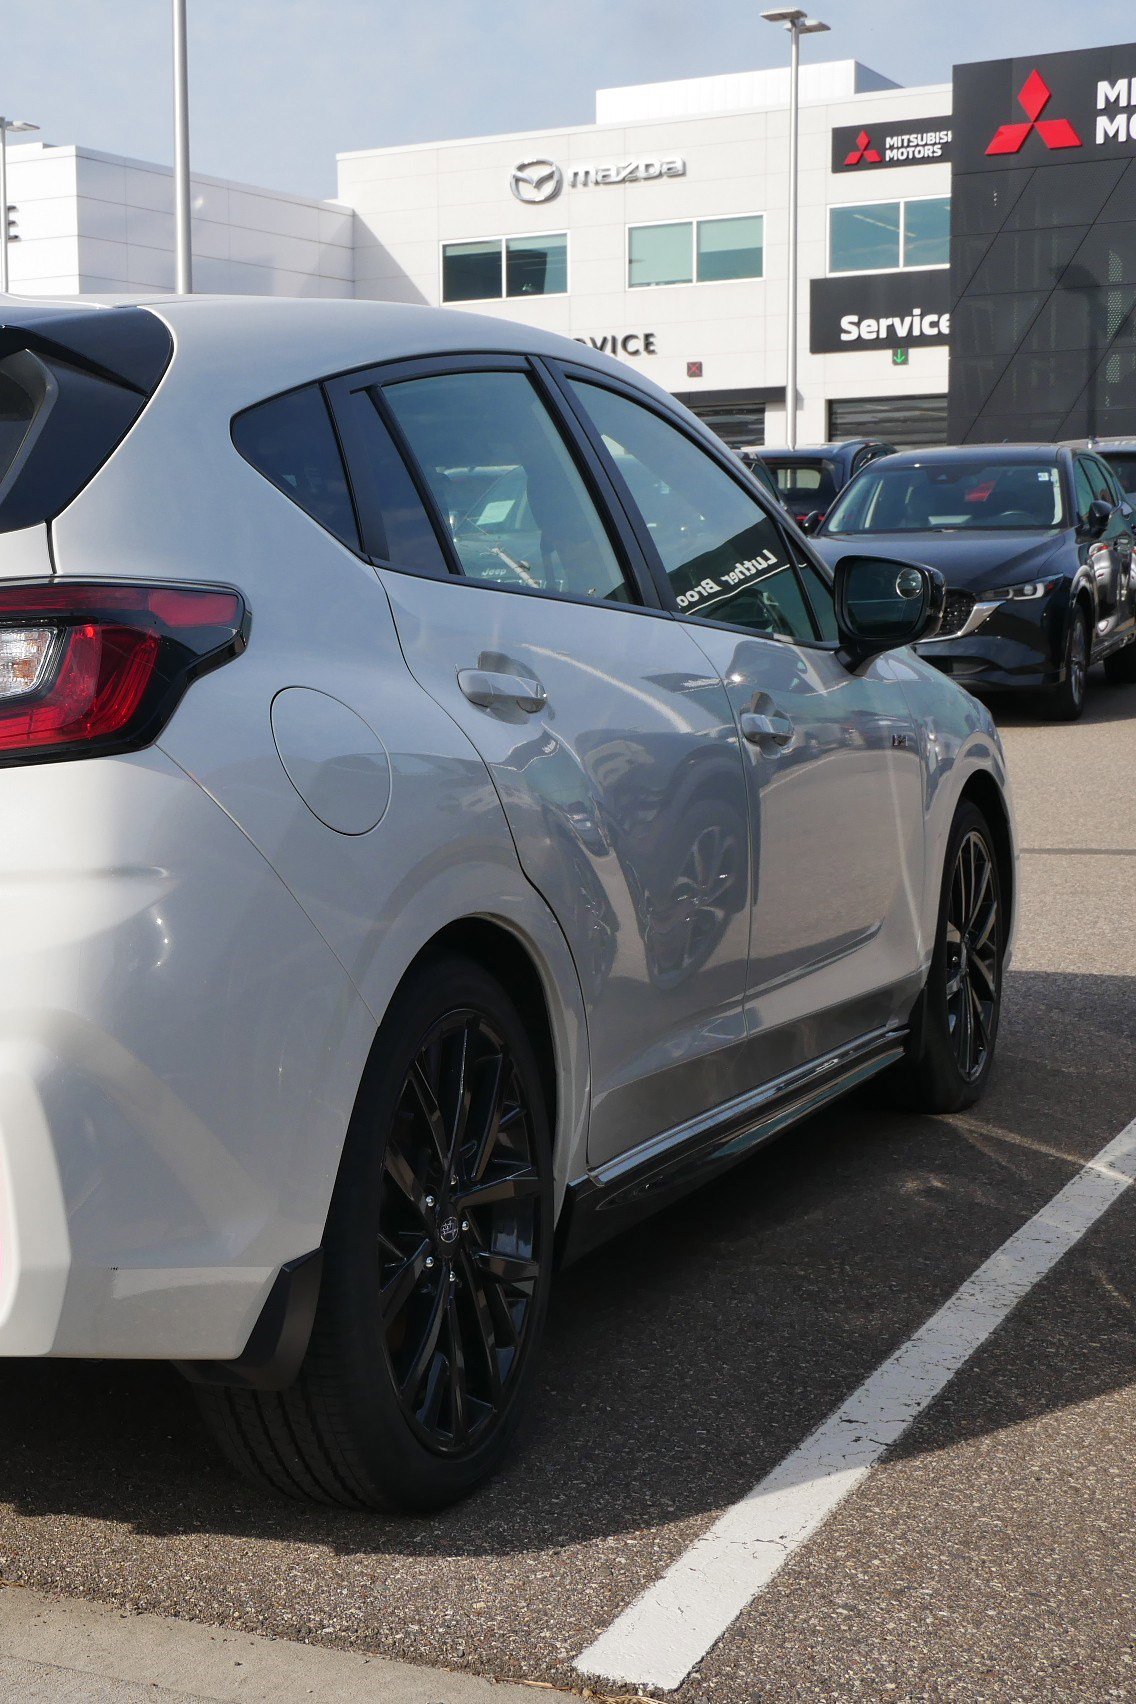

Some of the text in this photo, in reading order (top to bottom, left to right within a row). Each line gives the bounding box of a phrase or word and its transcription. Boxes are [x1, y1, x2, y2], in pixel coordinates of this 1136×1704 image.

[1095, 113, 1136, 145] M
[885, 145, 942, 161] MOTORS
[840, 308, 950, 341] Service
[573, 332, 658, 357] VICE
